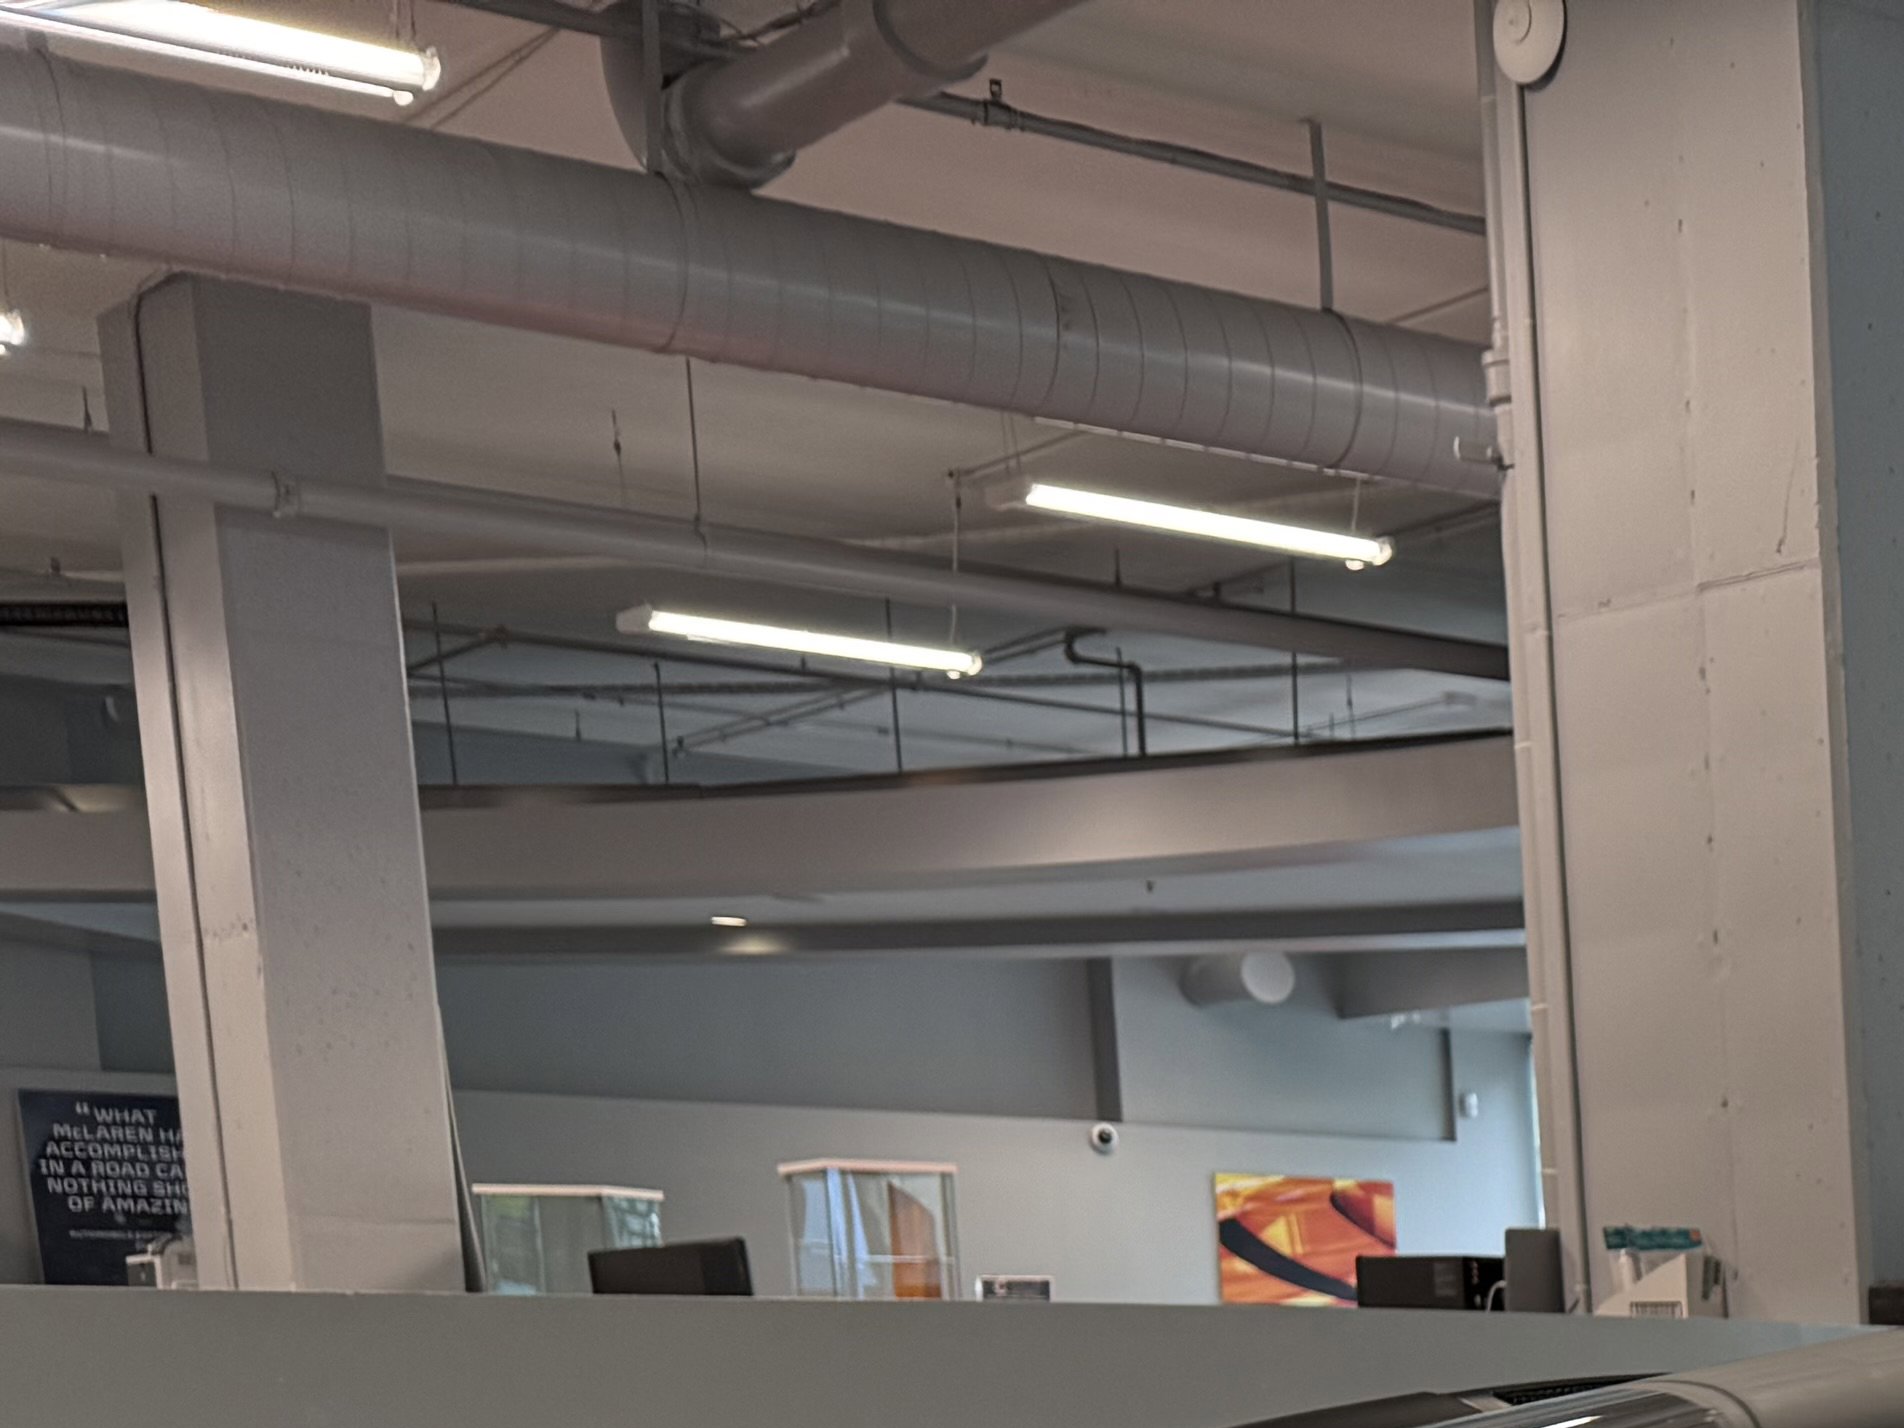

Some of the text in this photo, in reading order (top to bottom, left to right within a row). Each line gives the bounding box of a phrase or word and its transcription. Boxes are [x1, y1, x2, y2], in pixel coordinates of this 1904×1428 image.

[39, 1158, 65, 1176] IN
[71, 1160, 86, 1177] A
[91, 1161, 151, 1179] ROAD
[47, 1177, 148, 1196] NOTHING
[67, 1196, 94, 1213] OF
